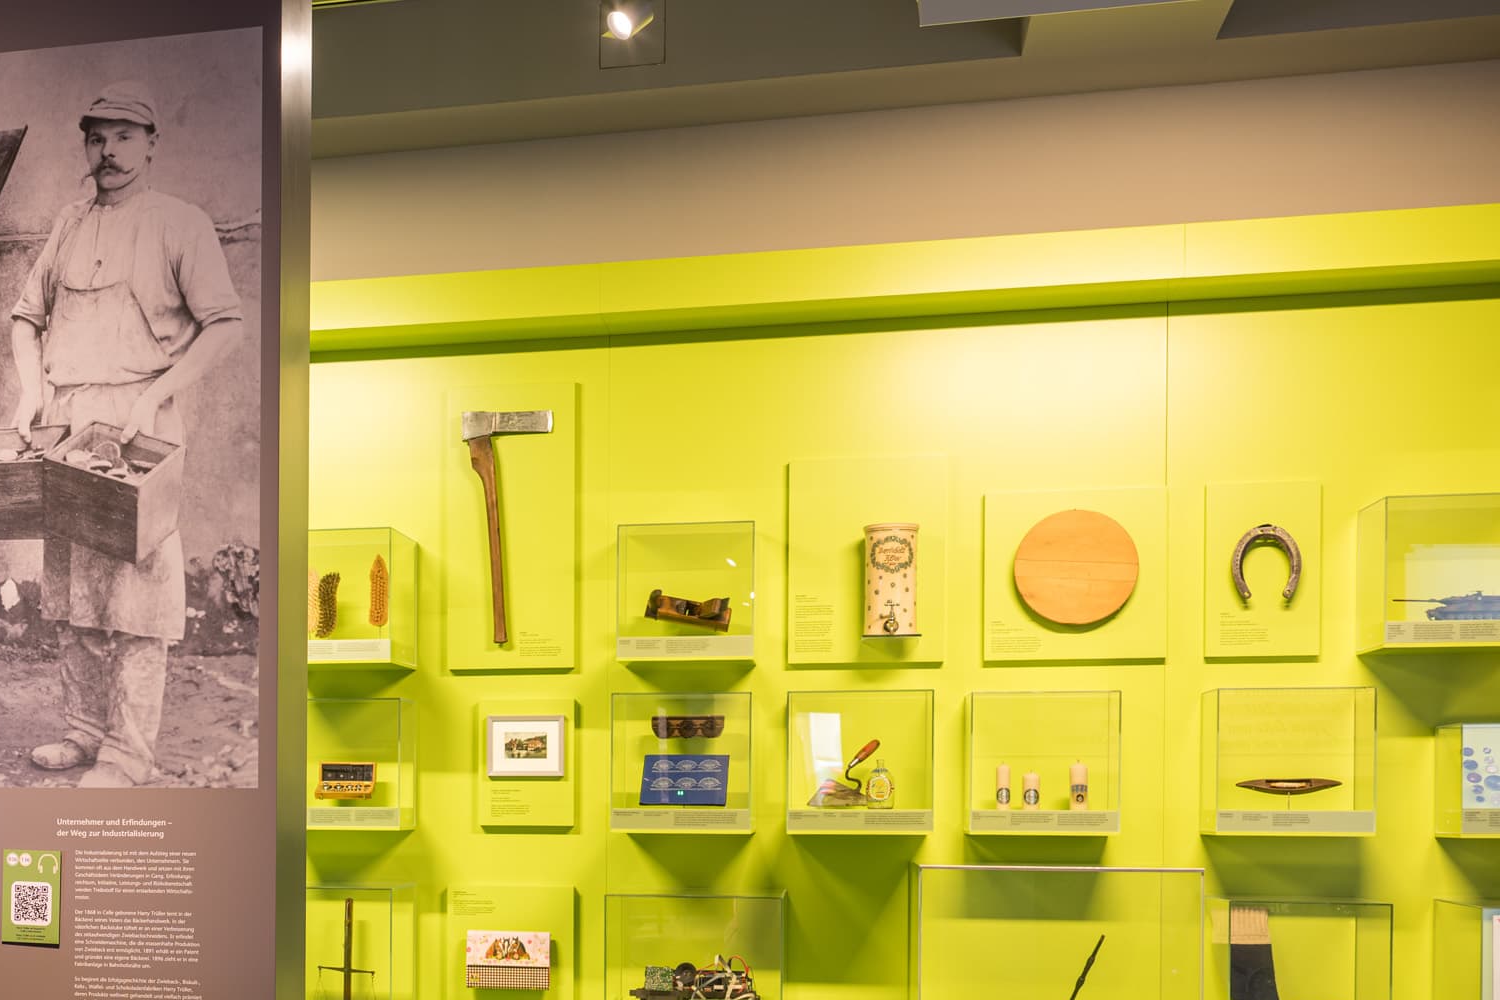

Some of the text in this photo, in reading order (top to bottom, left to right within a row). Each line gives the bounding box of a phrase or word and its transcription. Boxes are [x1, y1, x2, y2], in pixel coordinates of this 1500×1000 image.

[56, 818, 104, 826] Unternehmer
[106, 818, 120, 826] und
[122, 818, 166, 828] Erfindungen
[70, 830, 87, 838] Weg
[102, 830, 164, 839] Industrialisierung
